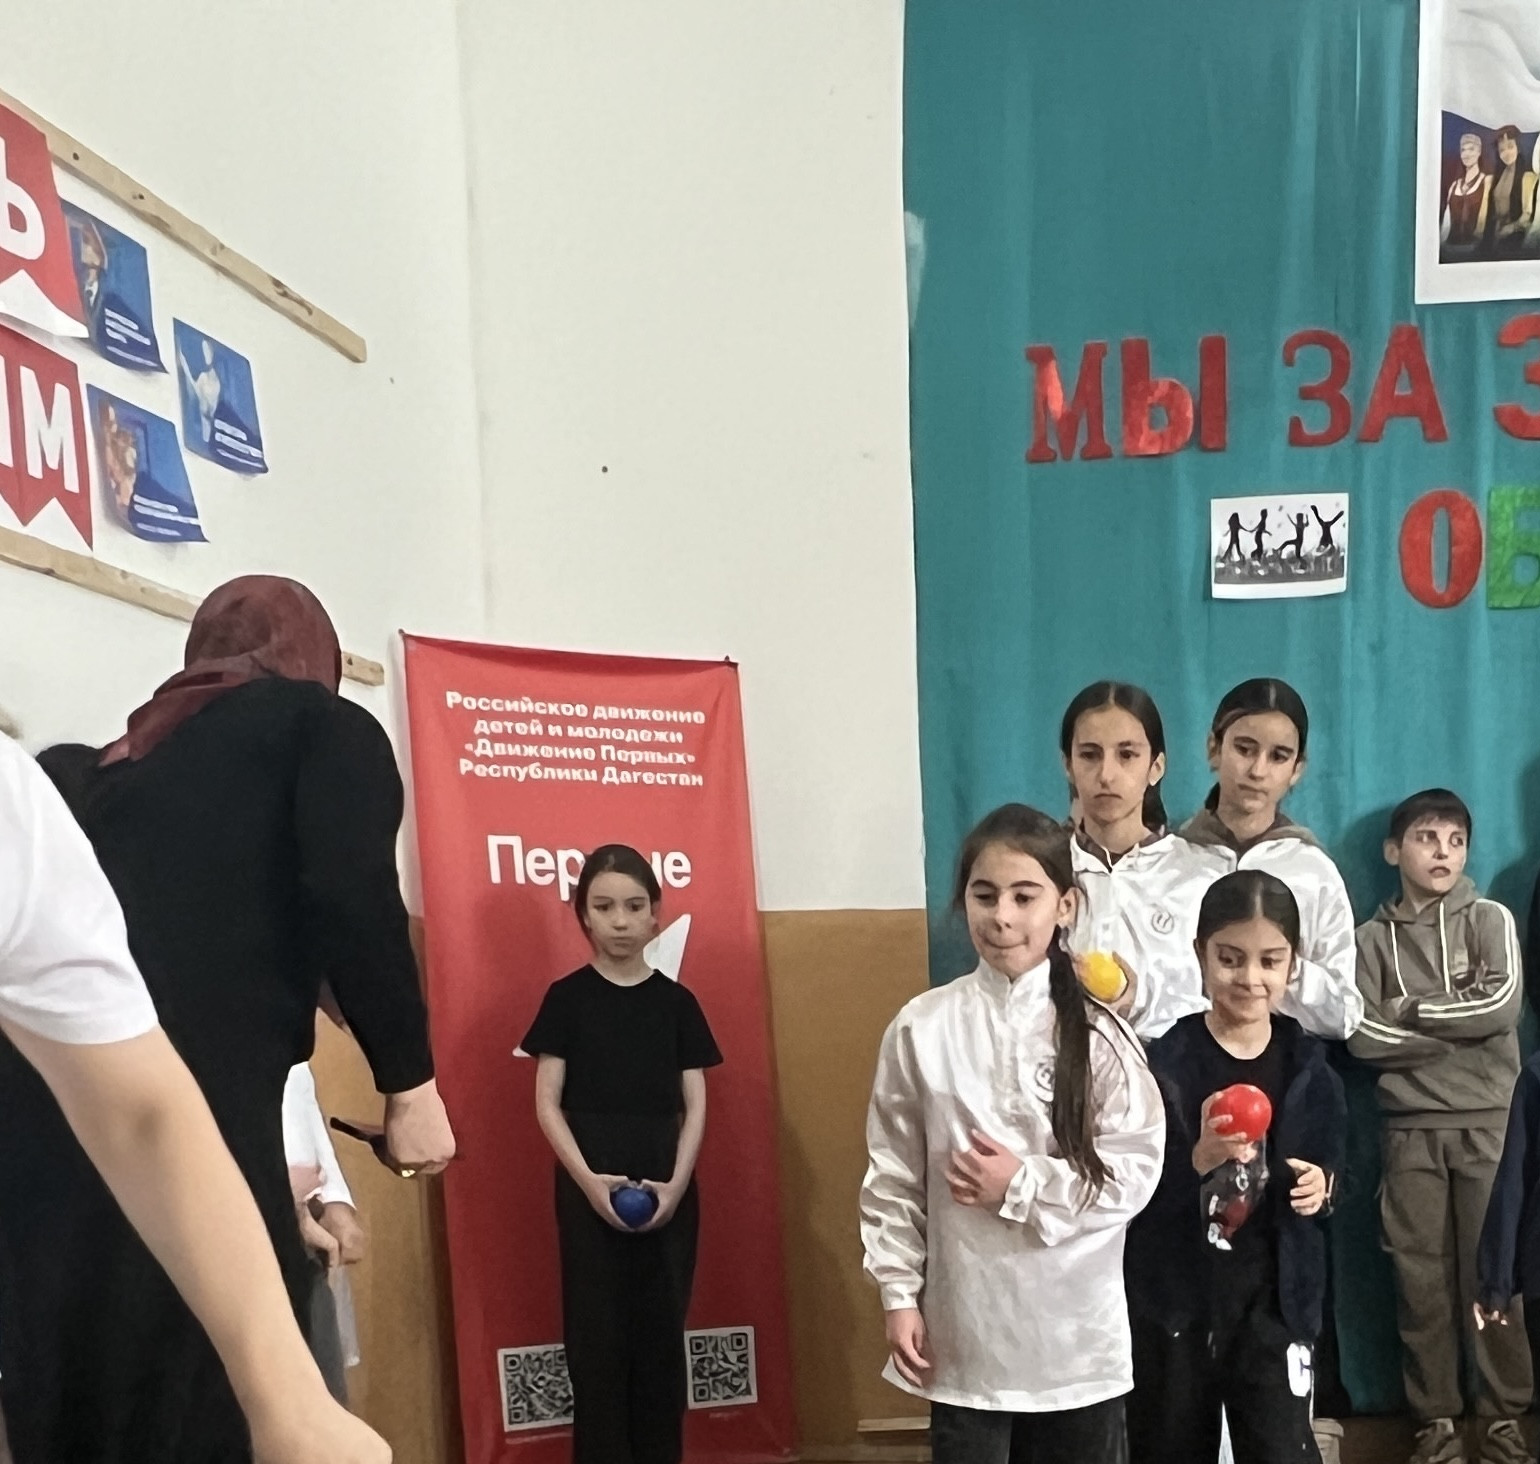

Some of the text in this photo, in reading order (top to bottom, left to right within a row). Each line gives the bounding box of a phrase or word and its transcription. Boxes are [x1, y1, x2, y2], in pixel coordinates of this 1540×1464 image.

[1025, 334, 1228, 463] МЫ
[1282, 322, 1449, 447] ЗА
[446, 690, 706, 724] Российское движение
[547, 723, 563, 737] и
[459, 758, 704, 787] Республики Дагестан
[487, 834, 693, 902] Пере
